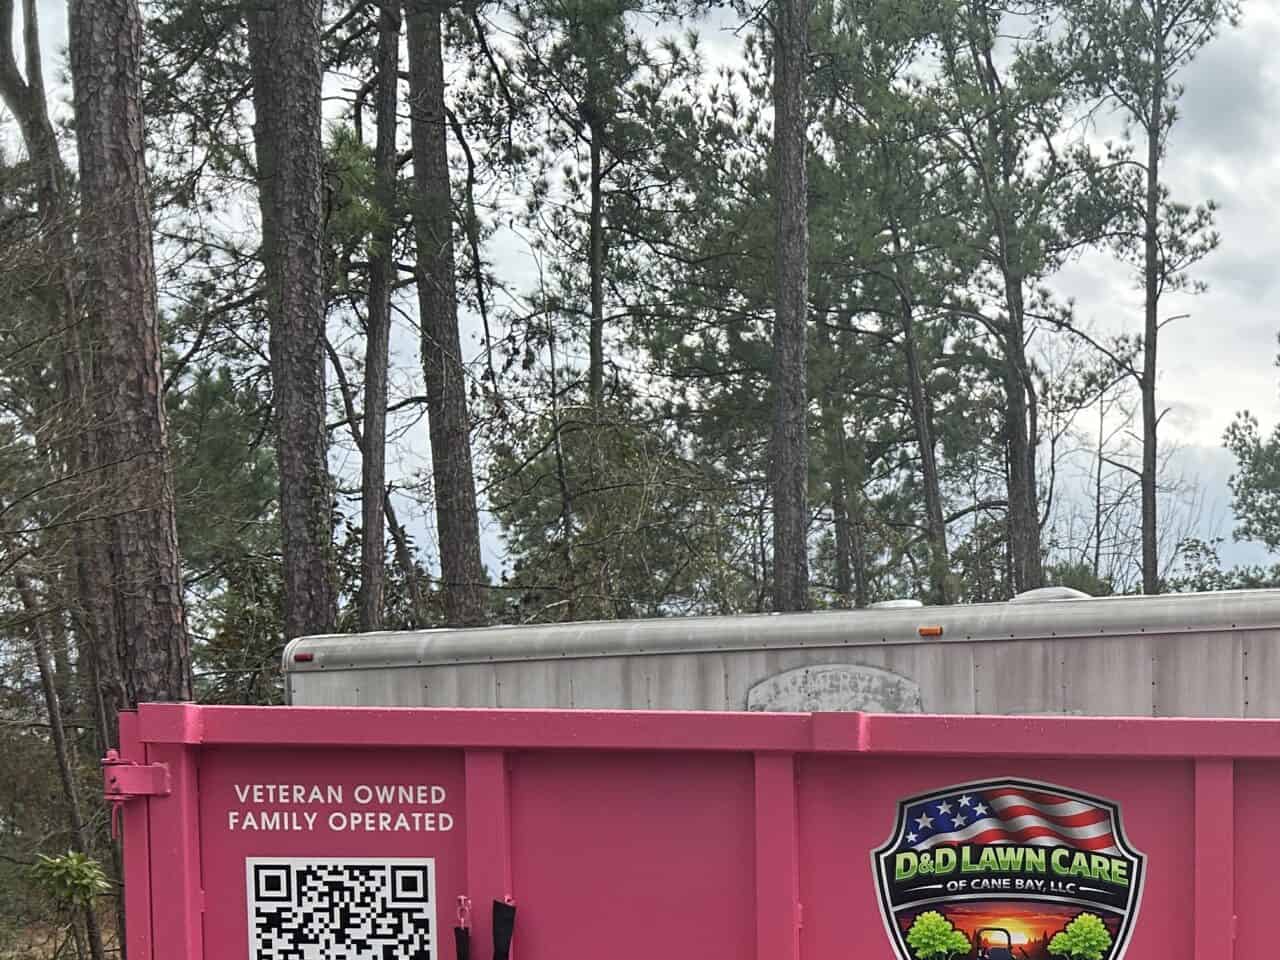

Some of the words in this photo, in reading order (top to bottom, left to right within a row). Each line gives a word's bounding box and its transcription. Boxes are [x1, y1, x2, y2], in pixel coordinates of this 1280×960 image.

[234, 784, 343, 804] VETERAN
[354, 785, 446, 804] OWNED
[228, 811, 318, 830] FAMILY
[328, 812, 454, 832] OPERATED
[895, 848, 957, 880] D&D
[961, 846, 1046, 874] LAWN
[1051, 848, 1129, 886] CARE
[946, 879, 968, 892] OF
[970, 878, 1011, 890] CANE
[1015, 879, 1047, 892] BAY,
[1050, 881, 1076, 894] LLC
